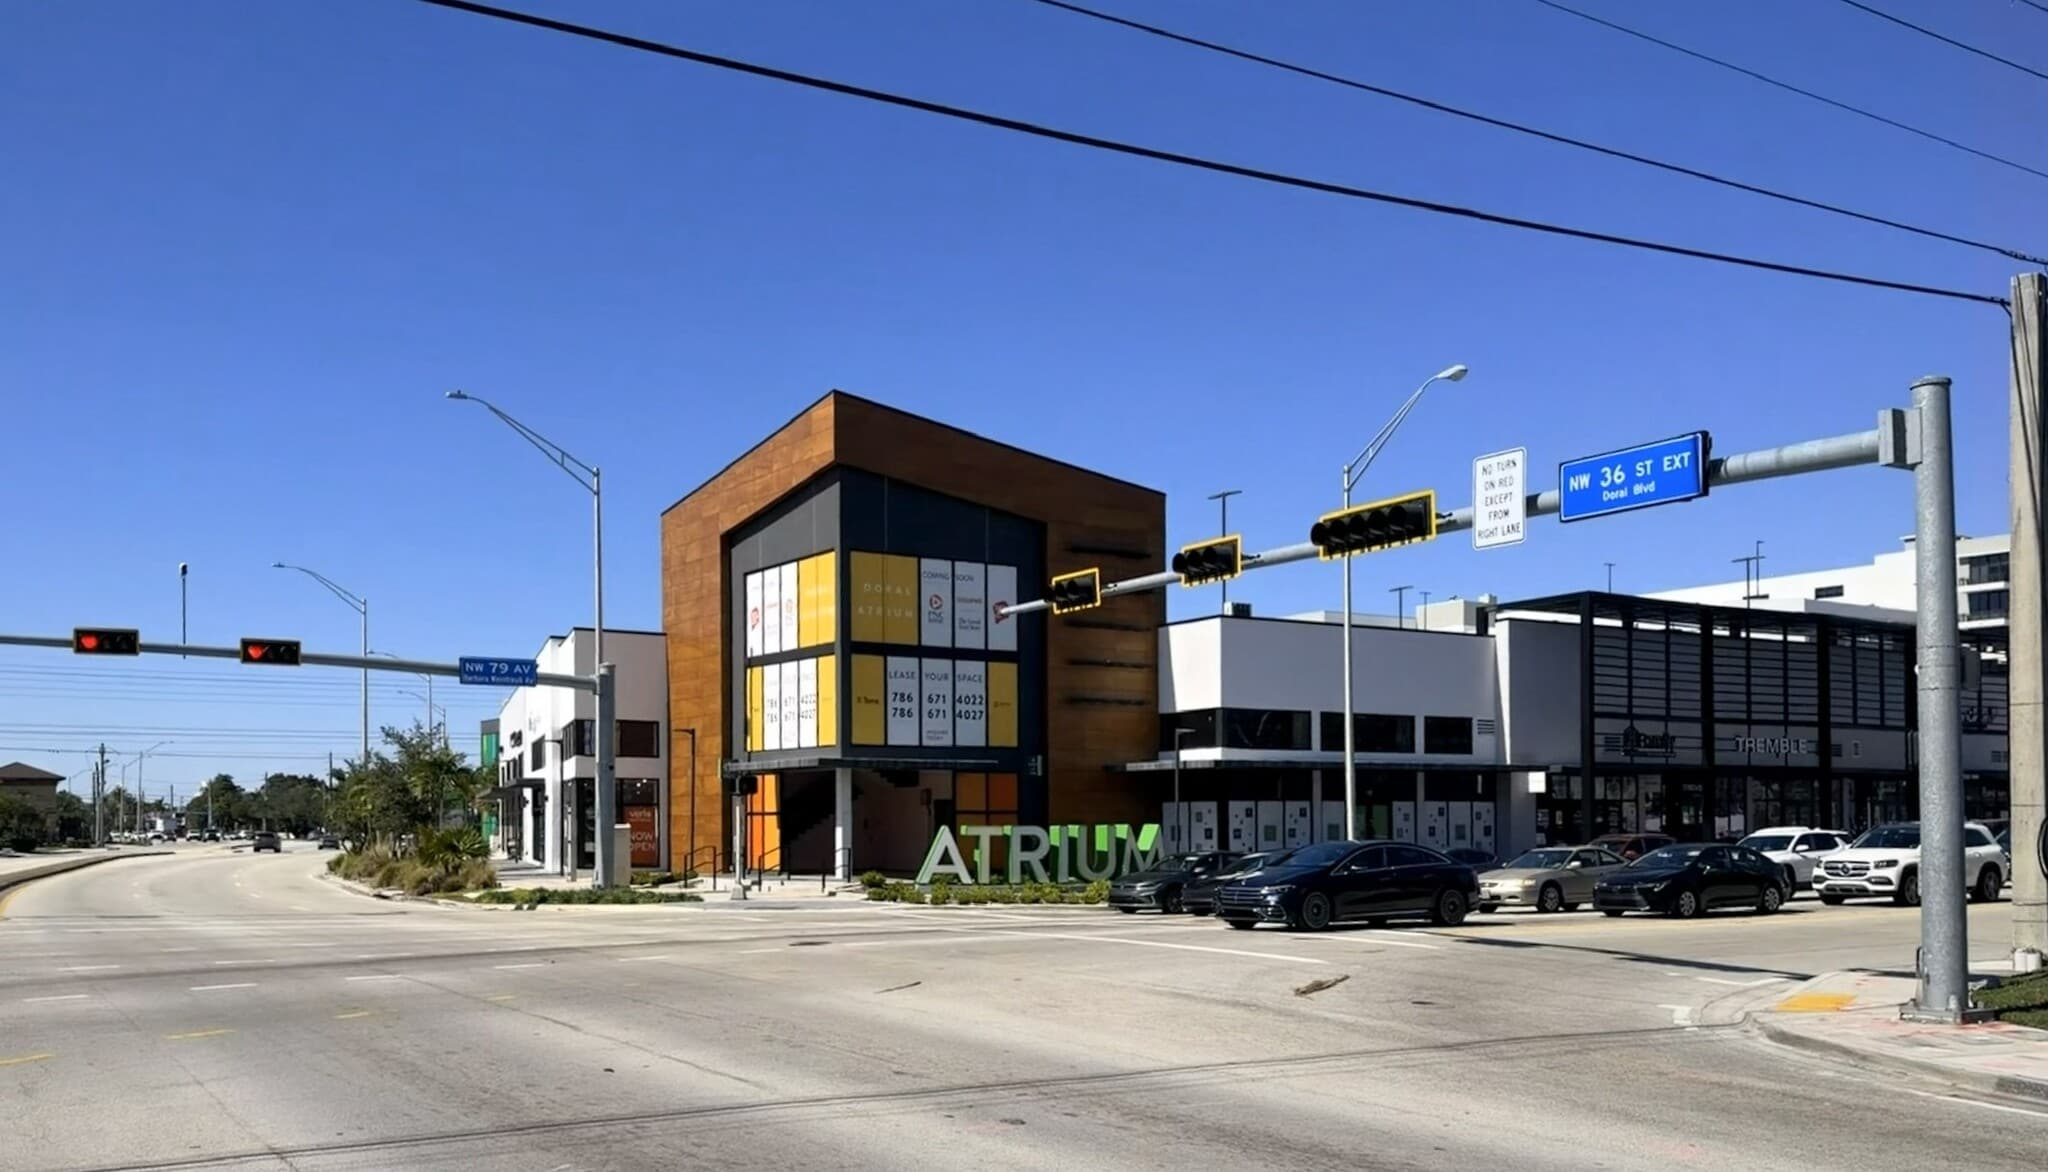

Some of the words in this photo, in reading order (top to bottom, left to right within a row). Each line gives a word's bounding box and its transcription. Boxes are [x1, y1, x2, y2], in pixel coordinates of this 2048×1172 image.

[1482, 464, 1492, 475] NO
[1497, 459, 1517, 471] TURN
[1569, 473, 1591, 492] NW
[1600, 464, 1626, 487] 36
[1635, 460, 1653, 477] ST
[1663, 451, 1691, 472] EXT
[1484, 481, 1495, 491] ON
[1498, 475, 1514, 487] RED
[1602, 487, 1628, 501] Doral
[1633, 481, 1656, 495] Blvd
[1484, 492, 1513, 507] EXCEPT
[1488, 509, 1510, 520] FROM
[1478, 526, 1498, 538] RIGHT
[1502, 522, 1520, 536] LANE
[864, 583, 910, 596] DORAL
[857, 606, 913, 617] ATRIUM
[465, 662, 484, 672] NW
[489, 662, 509, 674] 79
[513, 664, 531, 674] AV
[889, 671, 916, 680] LEASE
[925, 672, 949, 681] YOUR
[957, 674, 982, 683] SPACE
[892, 692, 914, 703] 786
[927, 694, 947, 704] 671
[956, 694, 984, 705] 4022
[892, 707, 914, 718] 786
[927, 708, 947, 719] 671
[956, 709, 984, 720] 4027
[1735, 737, 1807, 754] TREMBLE
[916, 824, 1168, 884] ATRIUM
